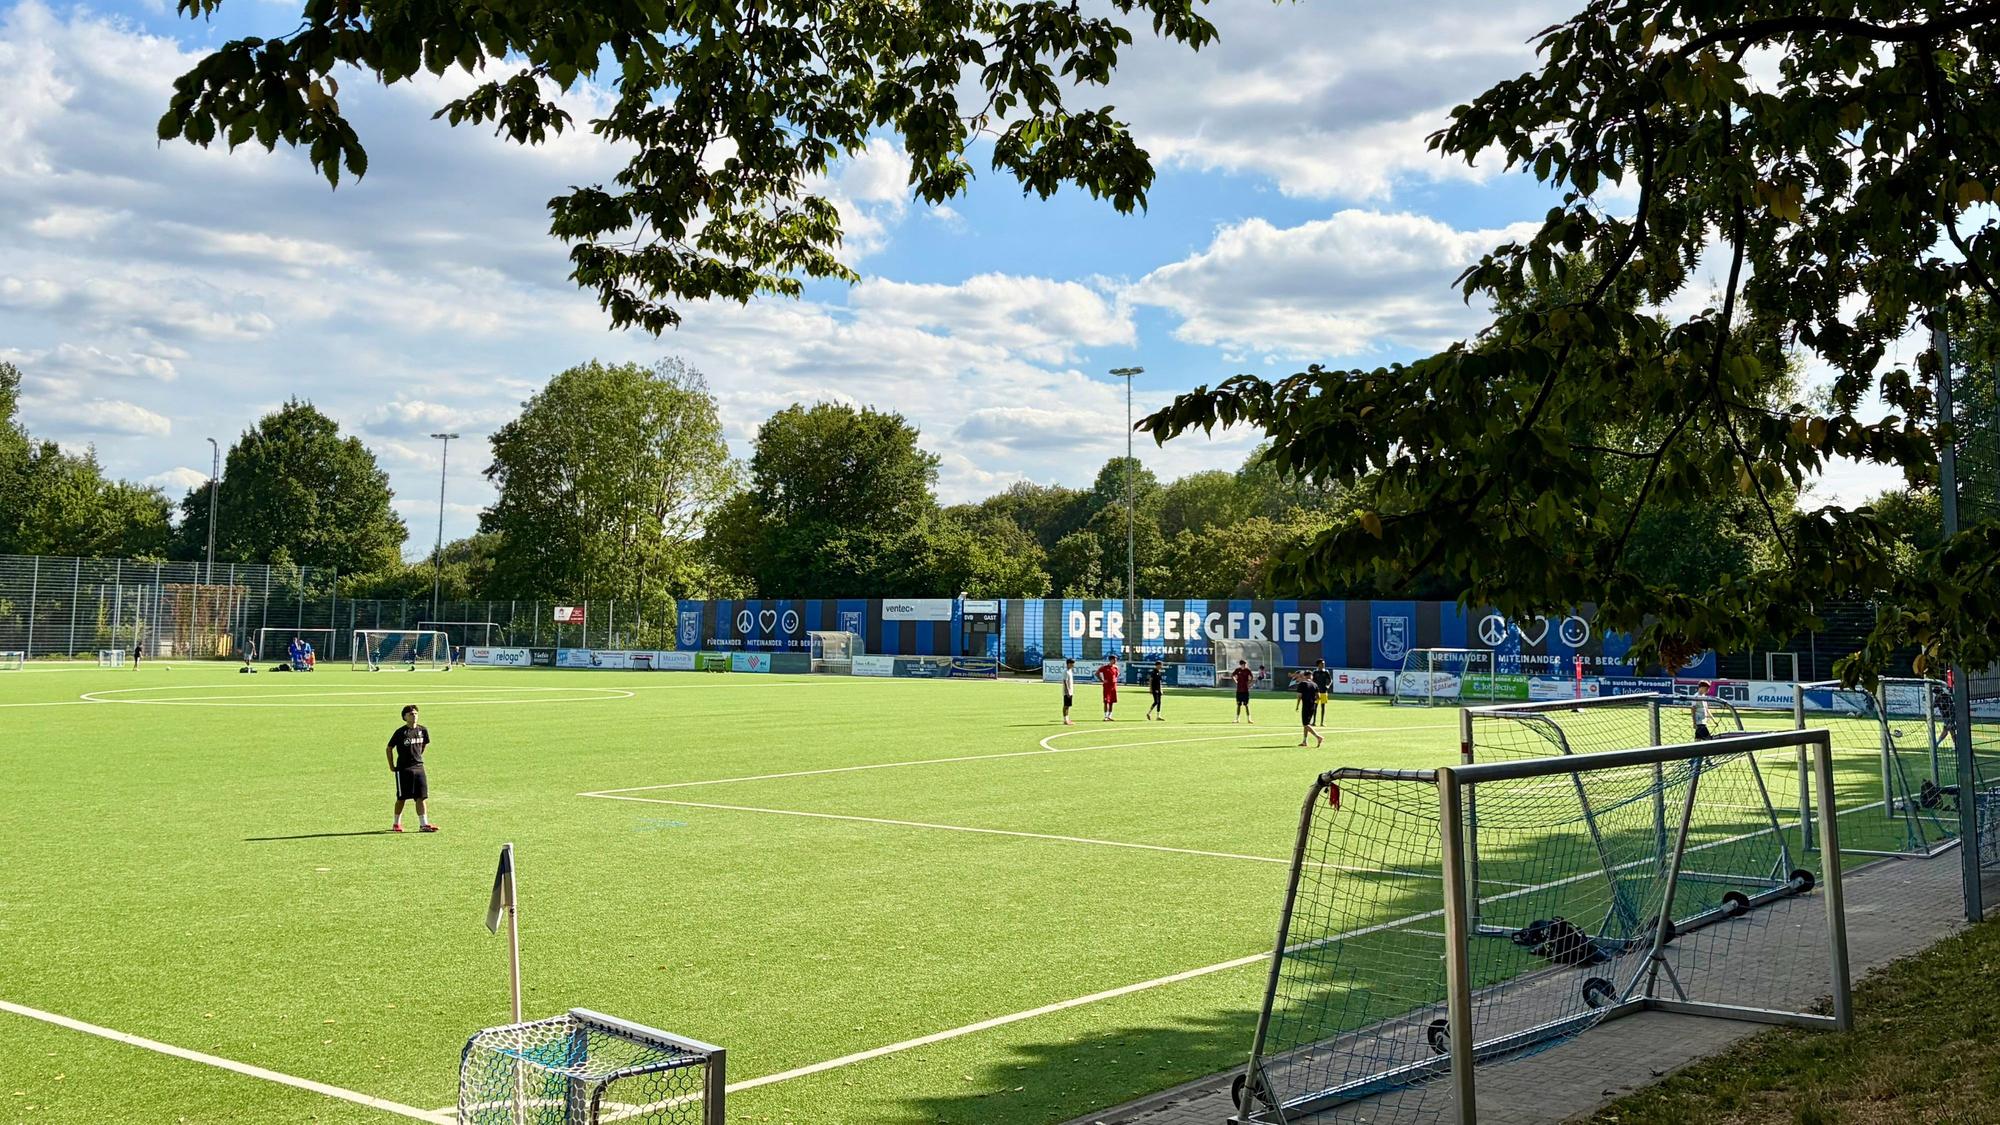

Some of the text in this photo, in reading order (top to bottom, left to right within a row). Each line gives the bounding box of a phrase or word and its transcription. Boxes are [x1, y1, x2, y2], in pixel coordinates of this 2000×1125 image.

[886, 604, 910, 612] ventec
[1069, 610, 1325, 642] DER BERGFRIED
[707, 637, 741, 646] FÜREINANDER
[747, 639, 783, 647] MITEINANDER
[787, 639, 799, 647] DER
[1120, 645, 1184, 655] FRUNDSCHAFT
[495, 650, 519, 664] reloga
[1498, 654, 1561, 664] MITEINANDER
[1572, 655, 1591, 665] DER
[1045, 662, 1091, 675] headoms
[1757, 695, 1795, 703] KRAHNE
